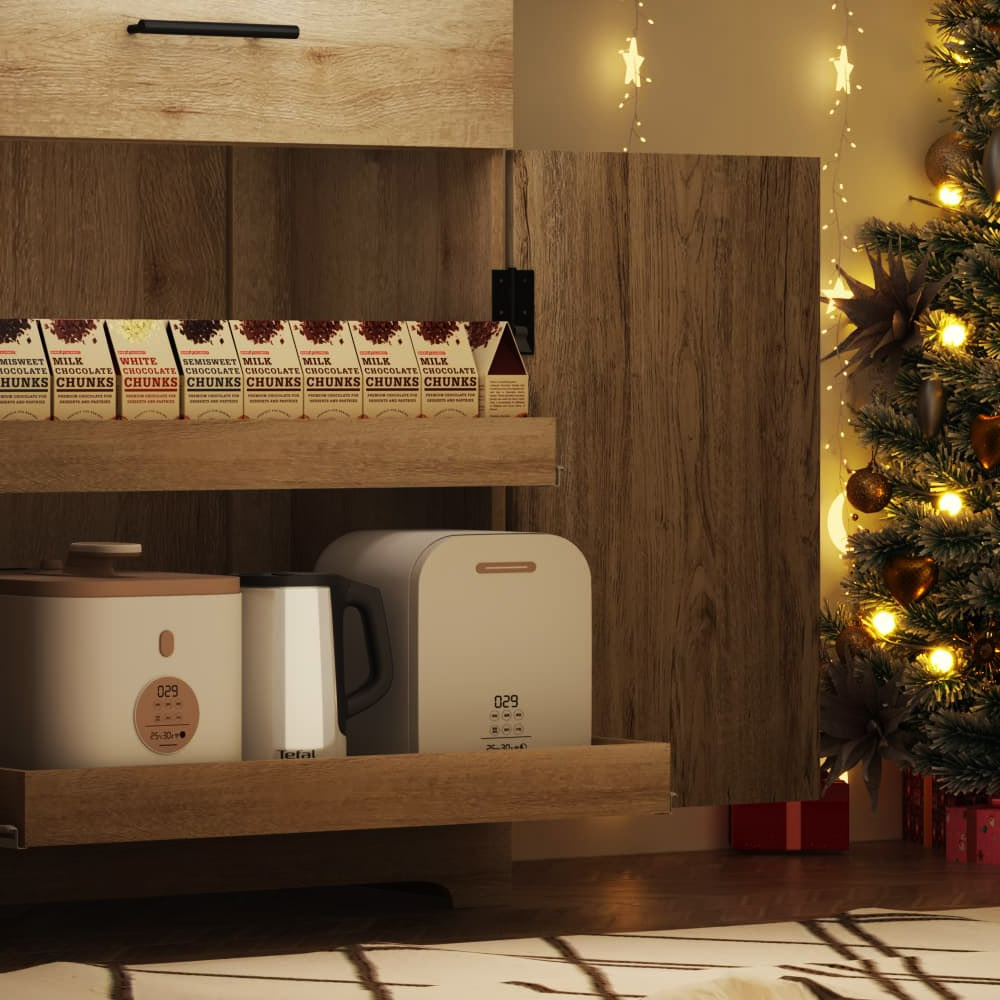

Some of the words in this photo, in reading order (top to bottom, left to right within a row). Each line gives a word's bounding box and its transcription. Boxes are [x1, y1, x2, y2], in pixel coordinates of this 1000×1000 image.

[53, 357, 84, 366] MILK
[120, 357, 158, 366] WHITE
[183, 358, 237, 366] SEMISWEET
[243, 357, 272, 366] MILK
[302, 357, 332, 366] MILK
[362, 357, 391, 366] MILK
[420, 357, 449, 366] MILK
[55, 367, 113, 375] CHOCOLATE
[123, 367, 177, 375] CHOCOLATE
[185, 367, 241, 375] CHOCOLATE
[245, 367, 301, 375] CHOCOLATE
[305, 367, 360, 375] CHOCOLATE
[364, 367, 418, 375] CHOCOLATE
[422, 367, 476, 375] CHOCOLATE
[56, 377, 114, 388] CHUNKS
[124, 377, 178, 388] CHUNKS
[187, 377, 241, 388] CHUNKS
[246, 376, 301, 388] CHUNKS
[306, 376, 361, 387] CHUNKS
[366, 376, 419, 387] CHUNKS
[424, 376, 477, 387] CHUNKS
[157, 684, 179, 698] 029
[494, 694, 518, 709] 029
[276, 749, 316, 760] Tefal
